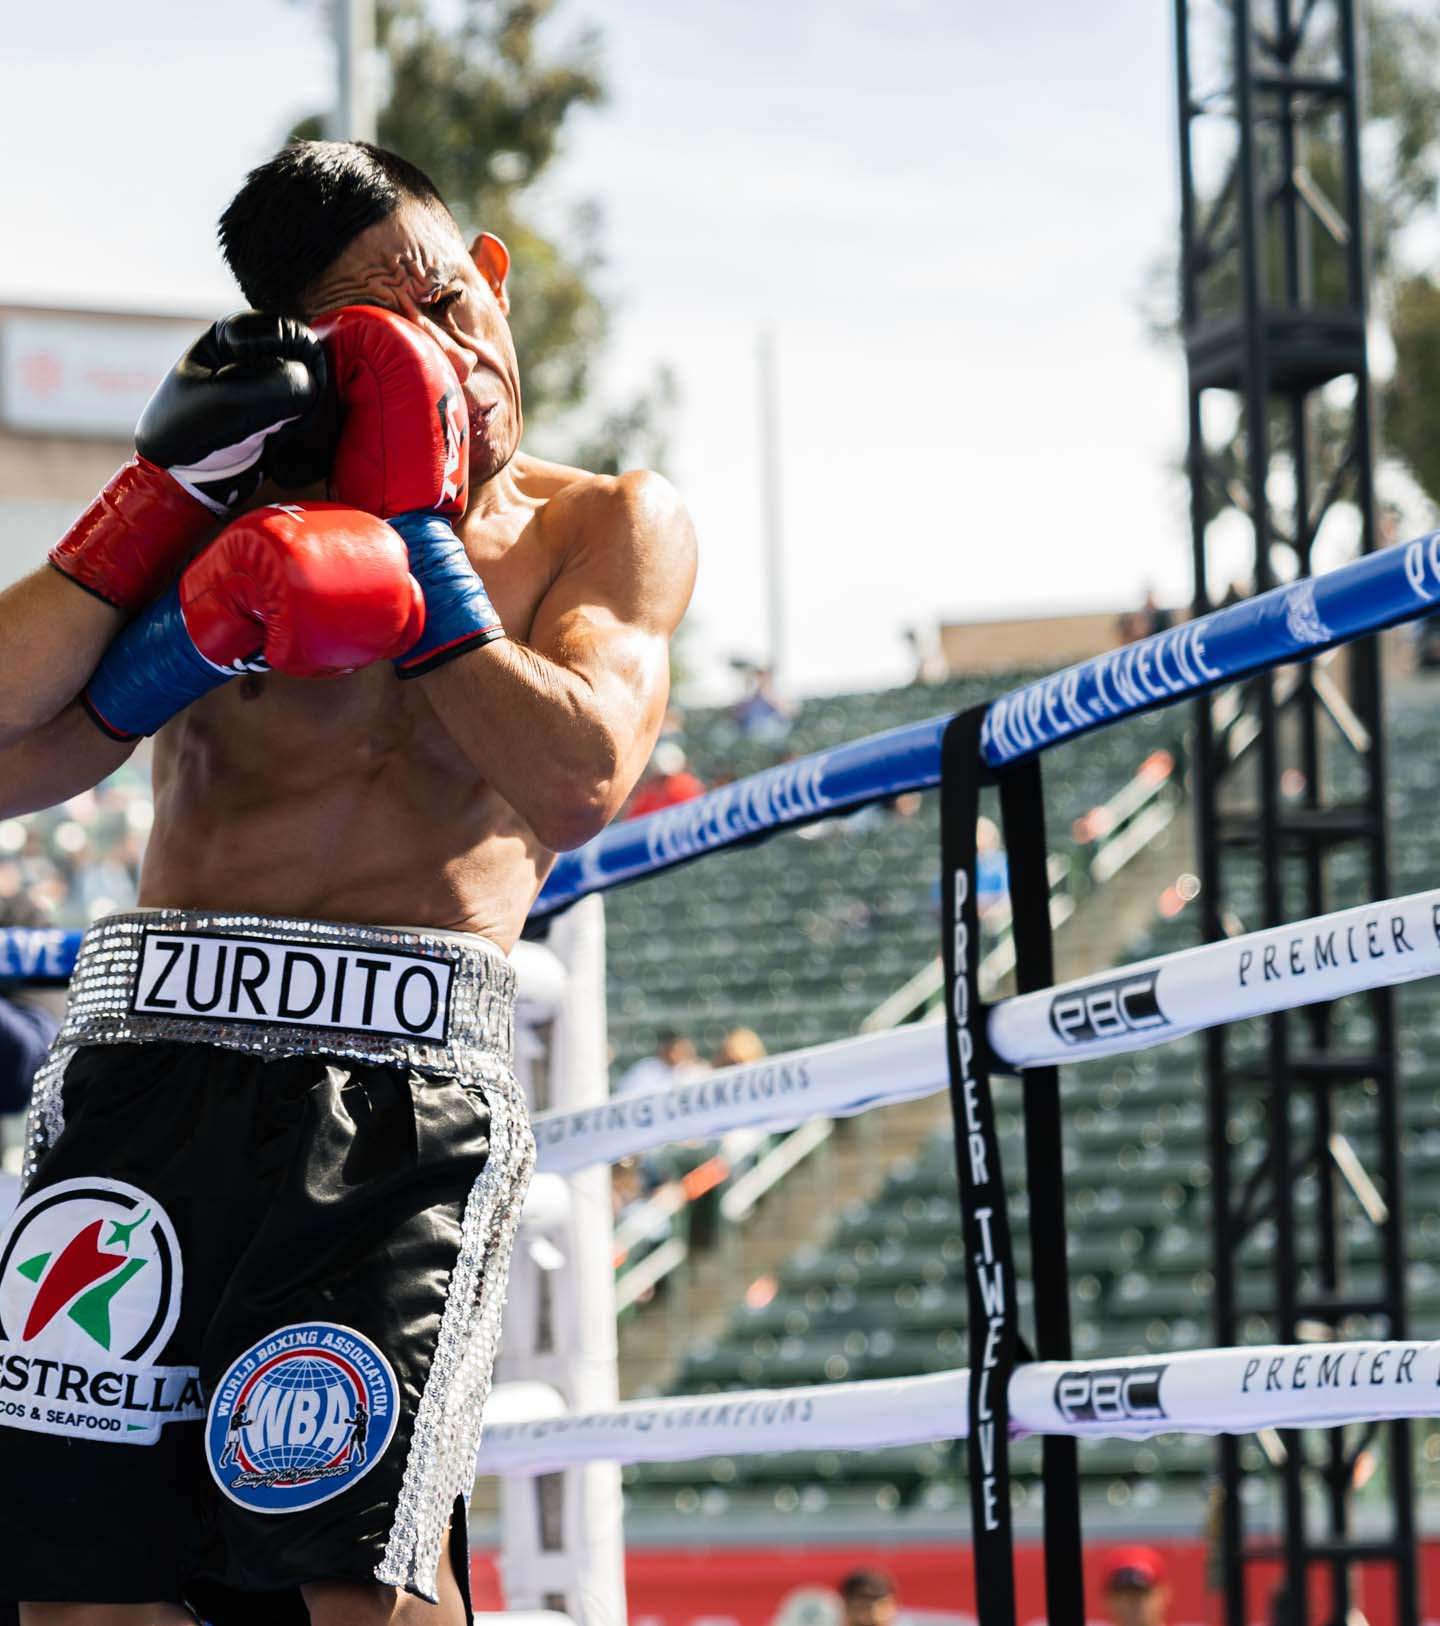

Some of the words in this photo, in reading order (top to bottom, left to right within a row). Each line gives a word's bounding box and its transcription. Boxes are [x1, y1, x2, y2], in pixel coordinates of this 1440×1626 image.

[1094, 623, 1222, 713] TWELVE
[1239, 916, 1414, 986] PREMIER
[144, 941, 439, 1034] ZURDITO
[1053, 980, 1164, 1044] PBC
[954, 868, 988, 1185] PROPER
[974, 1207, 1005, 1531] TWELVE
[217, 1358, 255, 1417] WORLD
[255, 1330, 319, 1363] BOXING
[320, 1332, 387, 1417] ASSOCIATION
[1060, 1372, 1160, 1423] PBC
[1242, 1348, 1417, 1392] PREMIER
[30, 1407, 41, 1421] &
[46, 1409, 121, 1431] SEAFOOD
[246, 1381, 350, 1454] WBA
